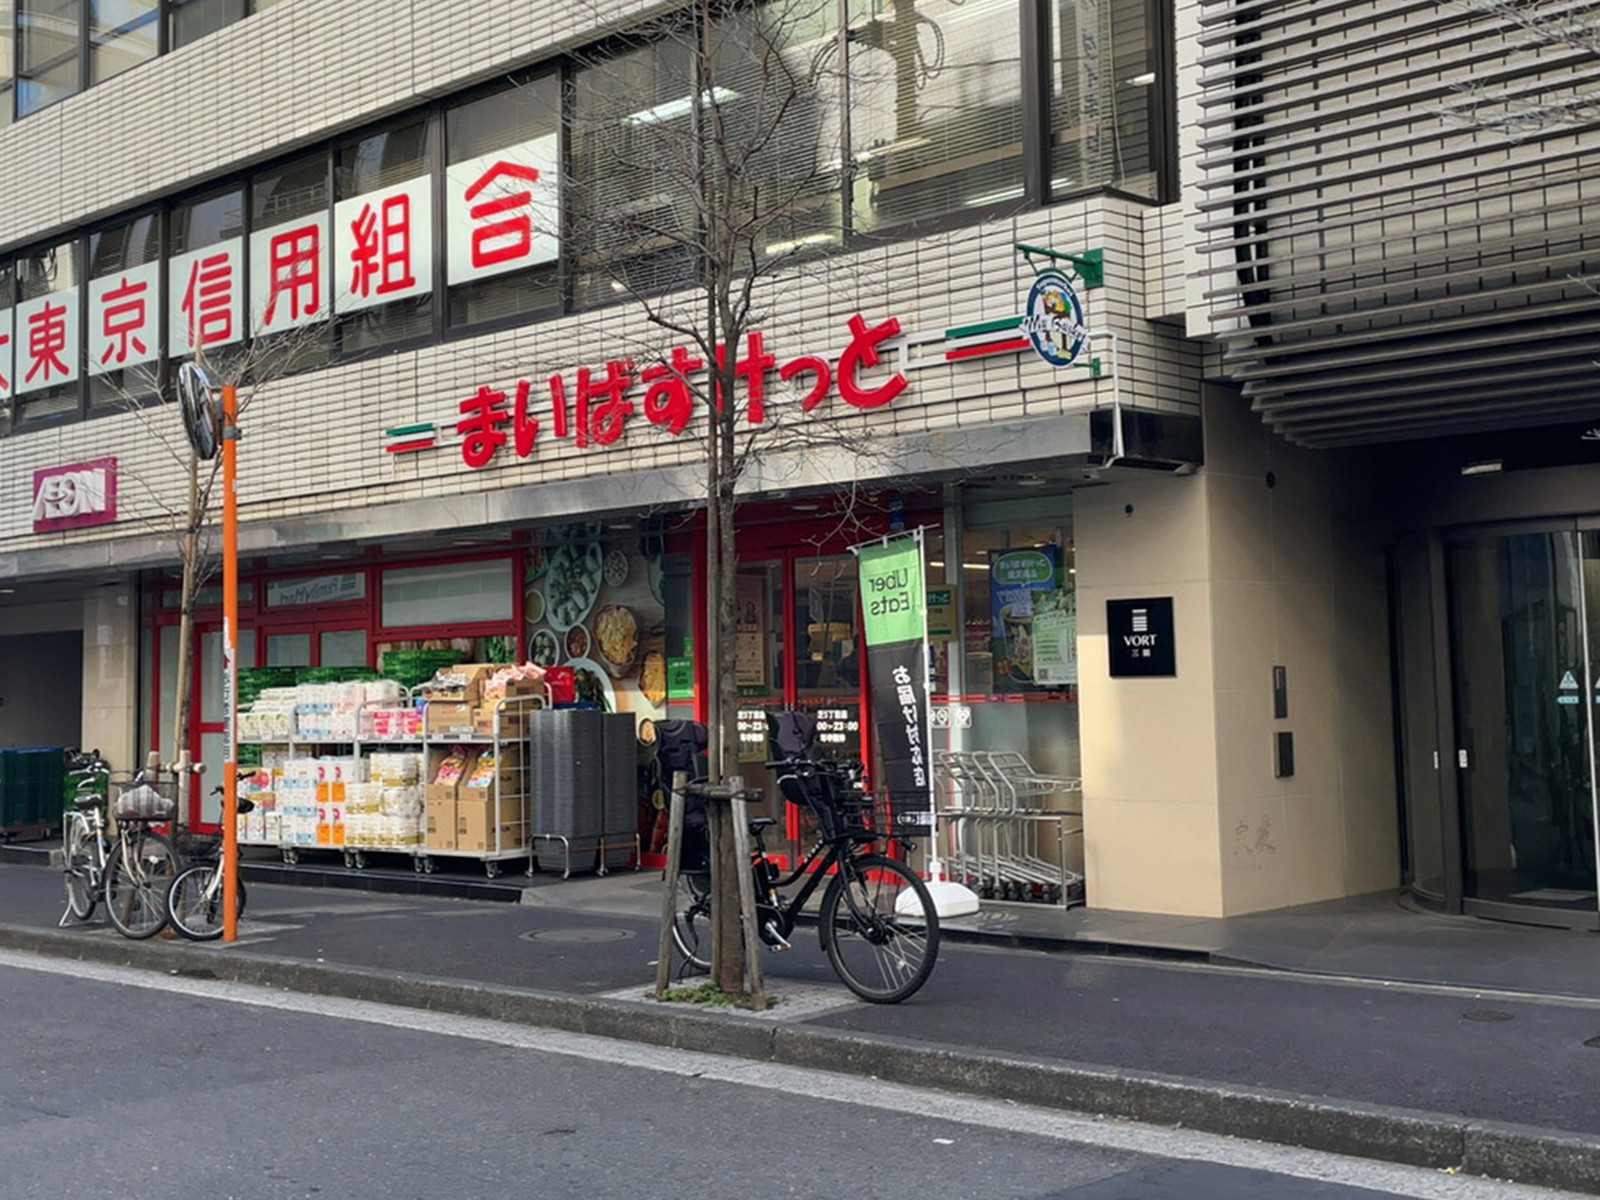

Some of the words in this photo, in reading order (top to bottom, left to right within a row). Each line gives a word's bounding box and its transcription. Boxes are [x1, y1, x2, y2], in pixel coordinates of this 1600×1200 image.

[456, 313, 908, 469] まいばすけっと
[31, 467, 107, 522] AEON
[1123, 633, 1157, 647] VORT
